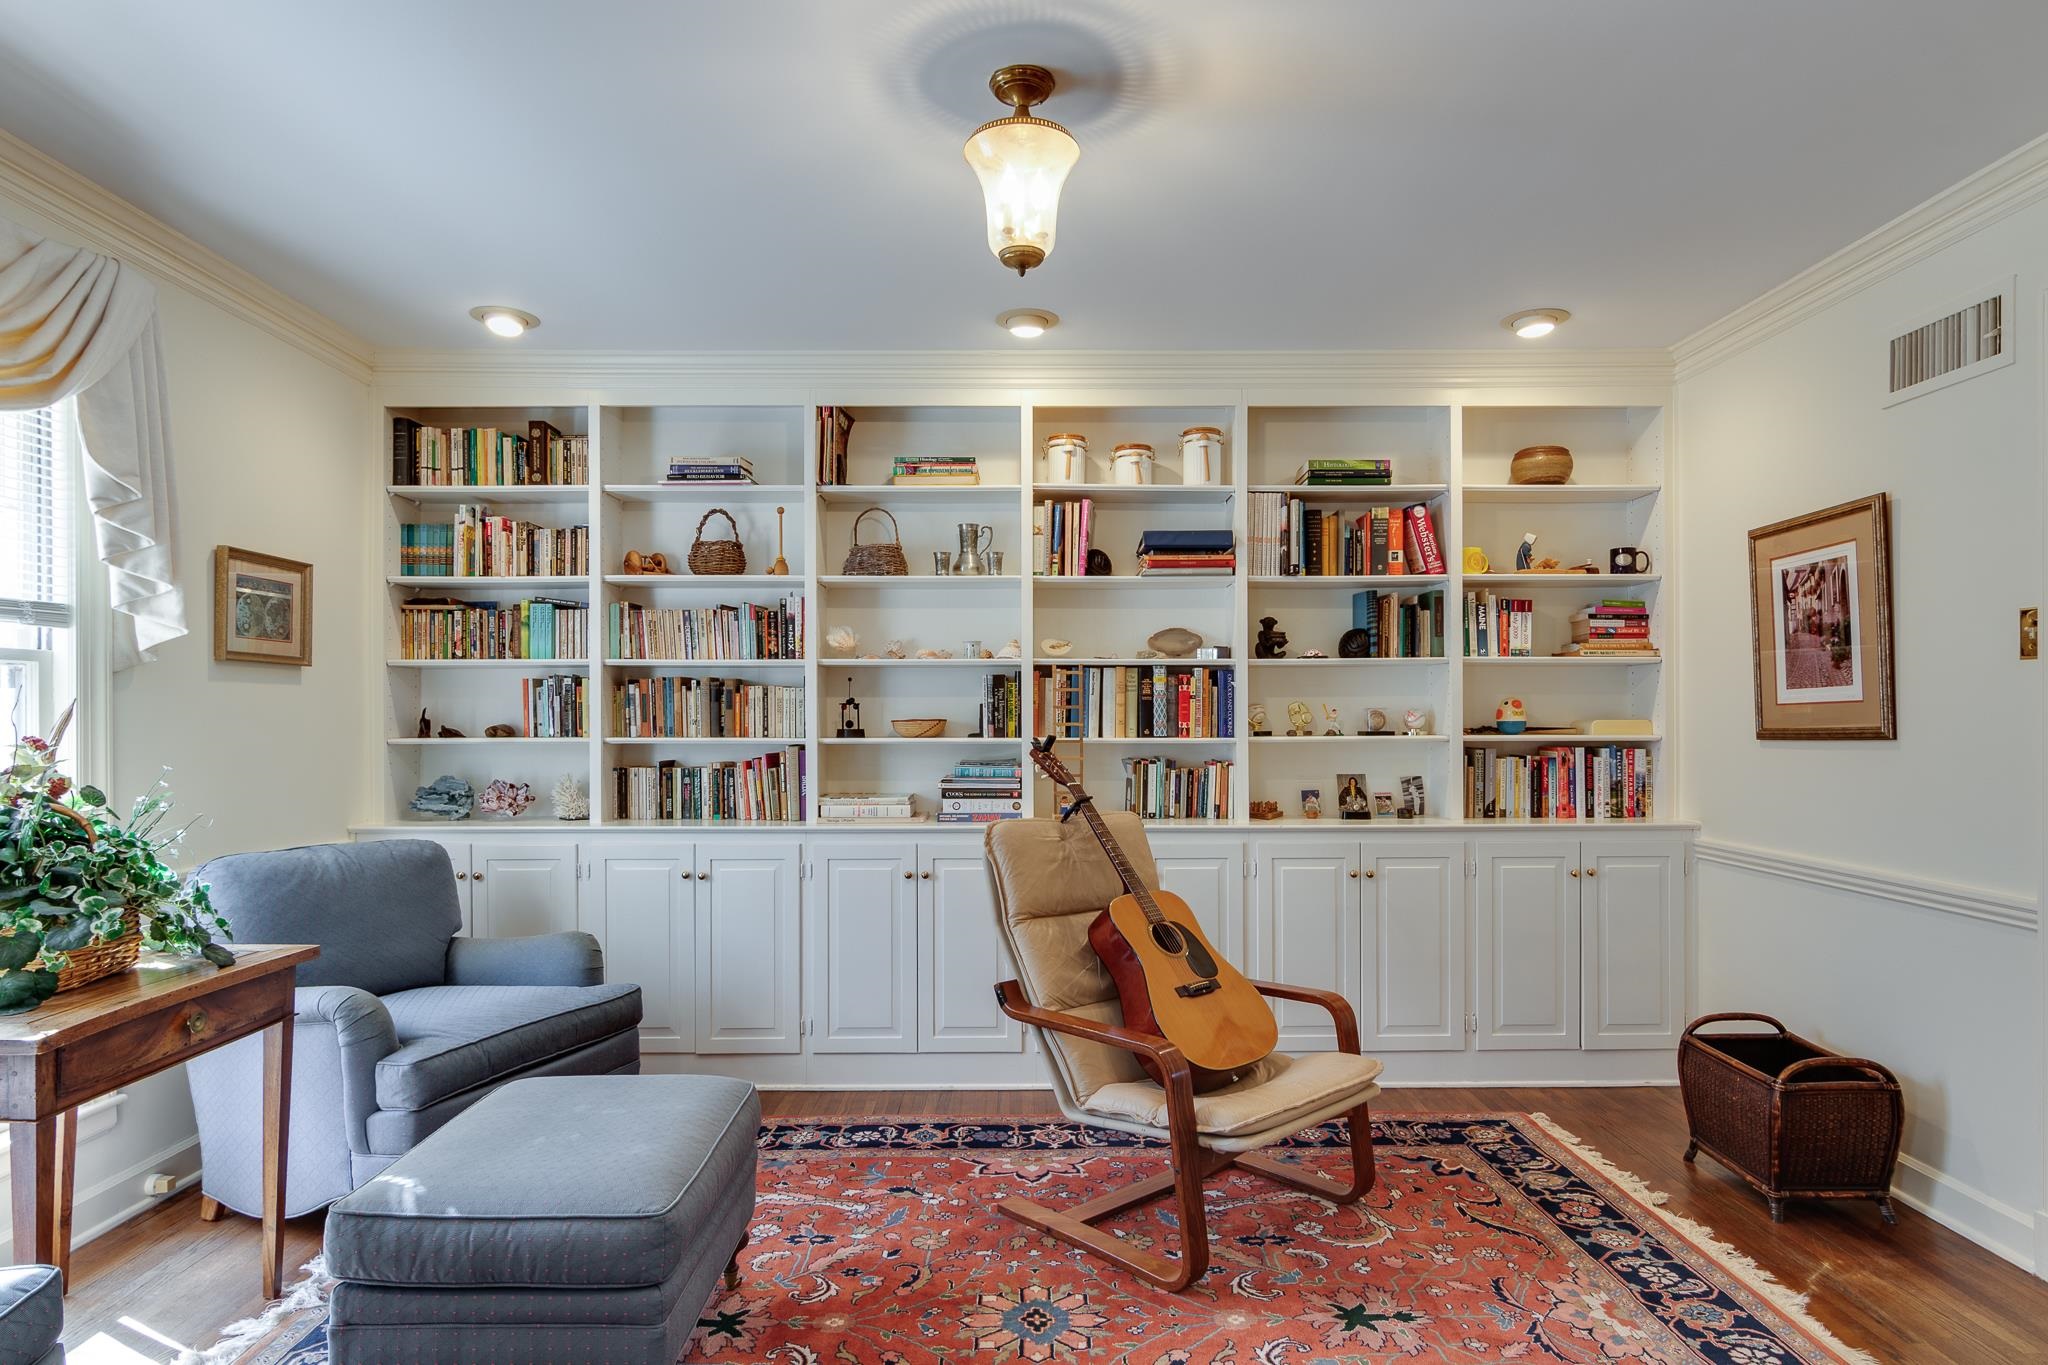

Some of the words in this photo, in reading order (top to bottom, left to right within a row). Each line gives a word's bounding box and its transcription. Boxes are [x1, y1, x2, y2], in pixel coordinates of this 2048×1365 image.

[1416, 517, 1435, 562] Webster's
[1478, 605, 1486, 630] MAINE
[1227, 674, 1232, 682] ON
